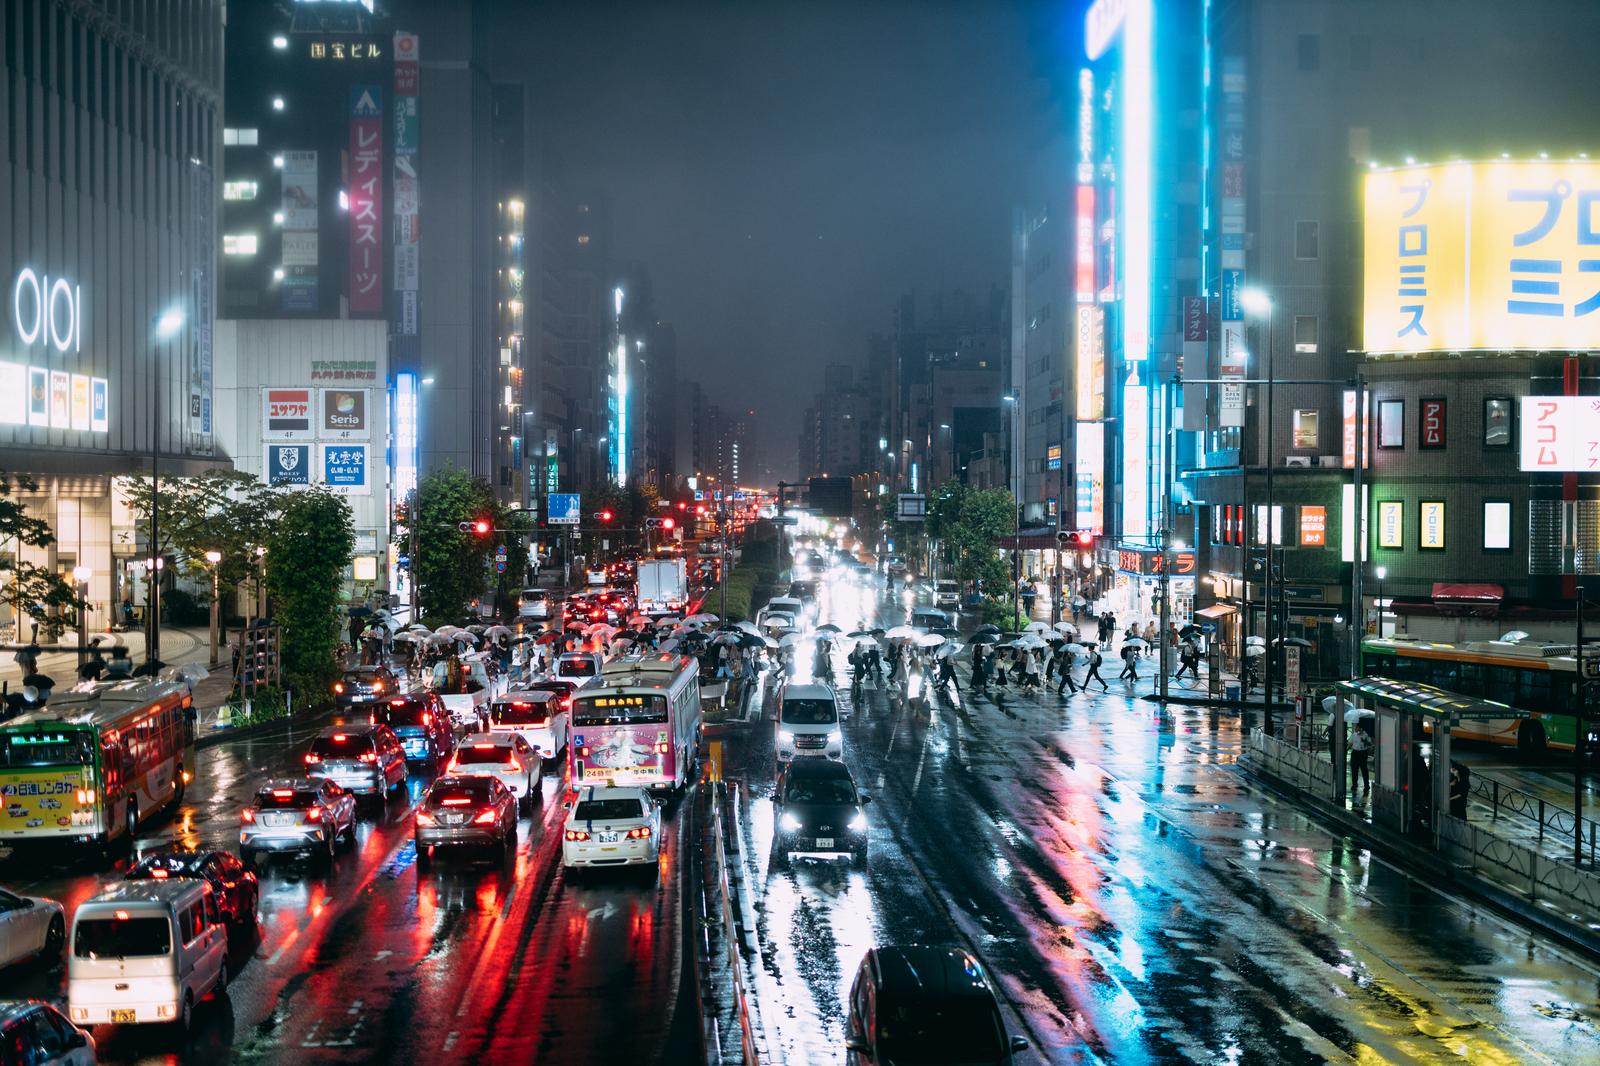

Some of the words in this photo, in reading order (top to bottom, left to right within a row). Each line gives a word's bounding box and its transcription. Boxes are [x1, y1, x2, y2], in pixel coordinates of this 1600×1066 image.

[311, 43, 381, 58] 国宝ビル
[355, 126, 379, 293] レディススーツ
[1397, 178, 1432, 338] プロミス
[1190, 298, 1200, 340] カラオケ
[330, 414, 359, 424] Seria
[1427, 404, 1440, 444] アコム
[1537, 402, 1558, 465] アコム
[328, 451, 363, 465] 光雲堂
[1387, 506, 1396, 544] プロミス
[1428, 506, 1437, 544] プロミス
[18, 782, 80, 797] 日進レンタカー
